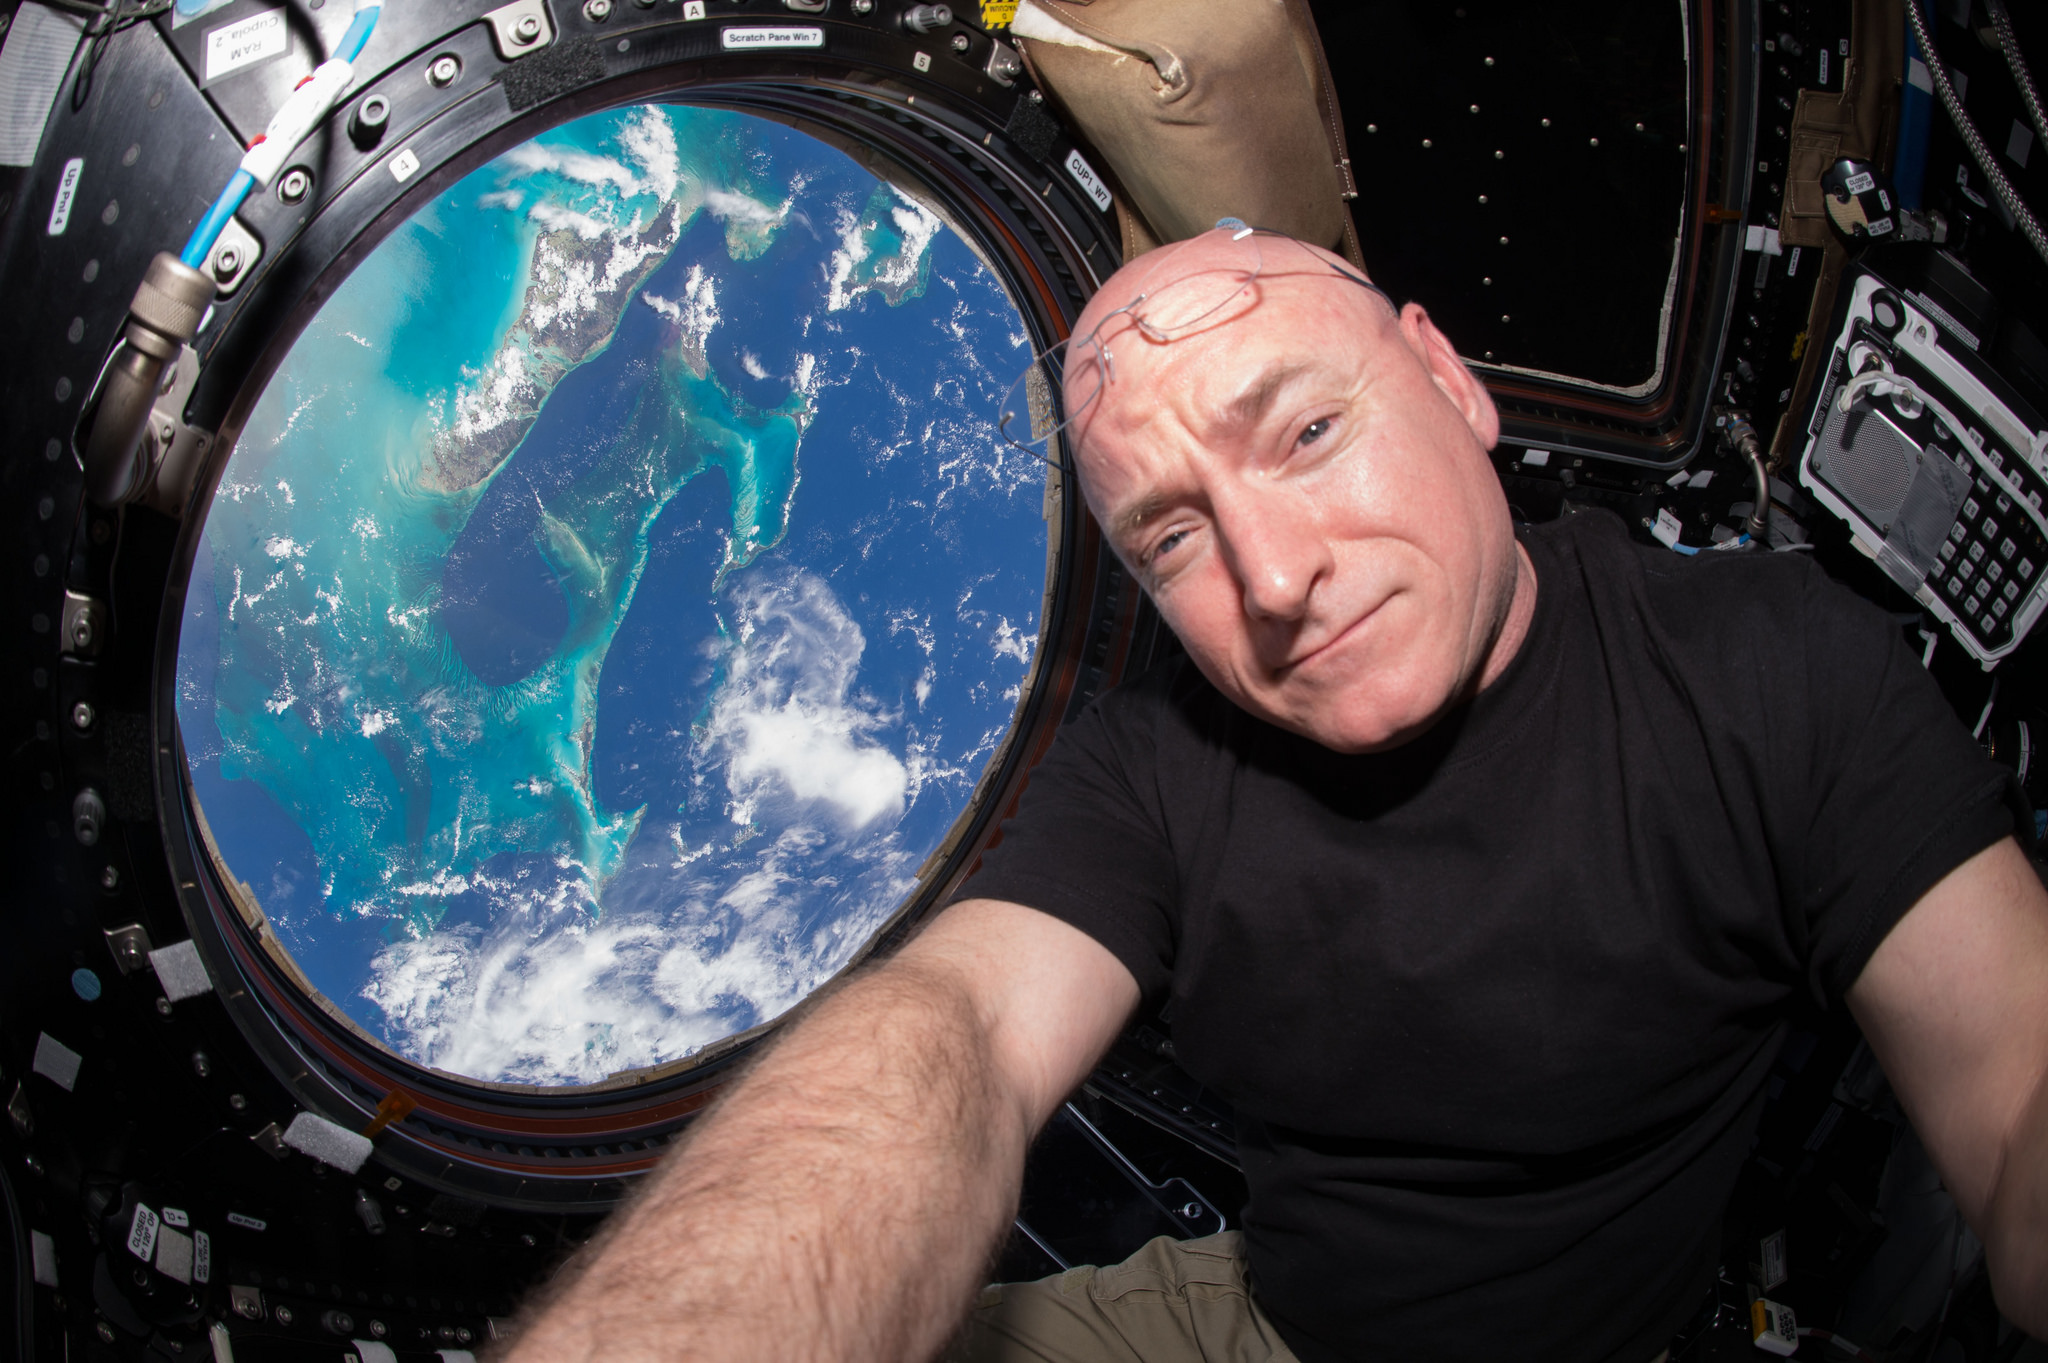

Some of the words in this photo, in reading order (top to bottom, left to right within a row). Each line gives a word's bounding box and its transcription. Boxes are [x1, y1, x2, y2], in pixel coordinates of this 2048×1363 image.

[690, 5, 700, 17] A
[988, 5, 1016, 13] VACUUM
[729, 33, 766, 43] Scratch
[768, 33, 791, 42] Pane
[792, 33, 810, 41] Win
[812, 33, 818, 41] 7
[231, 40, 262, 60] RAM
[918, 57, 926, 68] 5
[400, 159, 410, 171] 4
[64, 168, 78, 188] Up
[1848, 174, 1869, 186] CLOSED
[1865, 180, 1873, 188] OP
[57, 191, 71, 214] Pnl
[54, 217, 63, 225] 4
[1814, 409, 1826, 433] AUDIO
[1822, 375, 1838, 409] TERMINAL
[1833, 354, 1845, 374] UNIT
[231, 1215, 243, 1223] Up
[131, 1211, 147, 1249] CLOSED
[141, 1247, 148, 1259] or
[147, 1211, 155, 1228] OP
[197, 1264, 203, 1278] OP
[202, 1264, 208, 1279] OP
